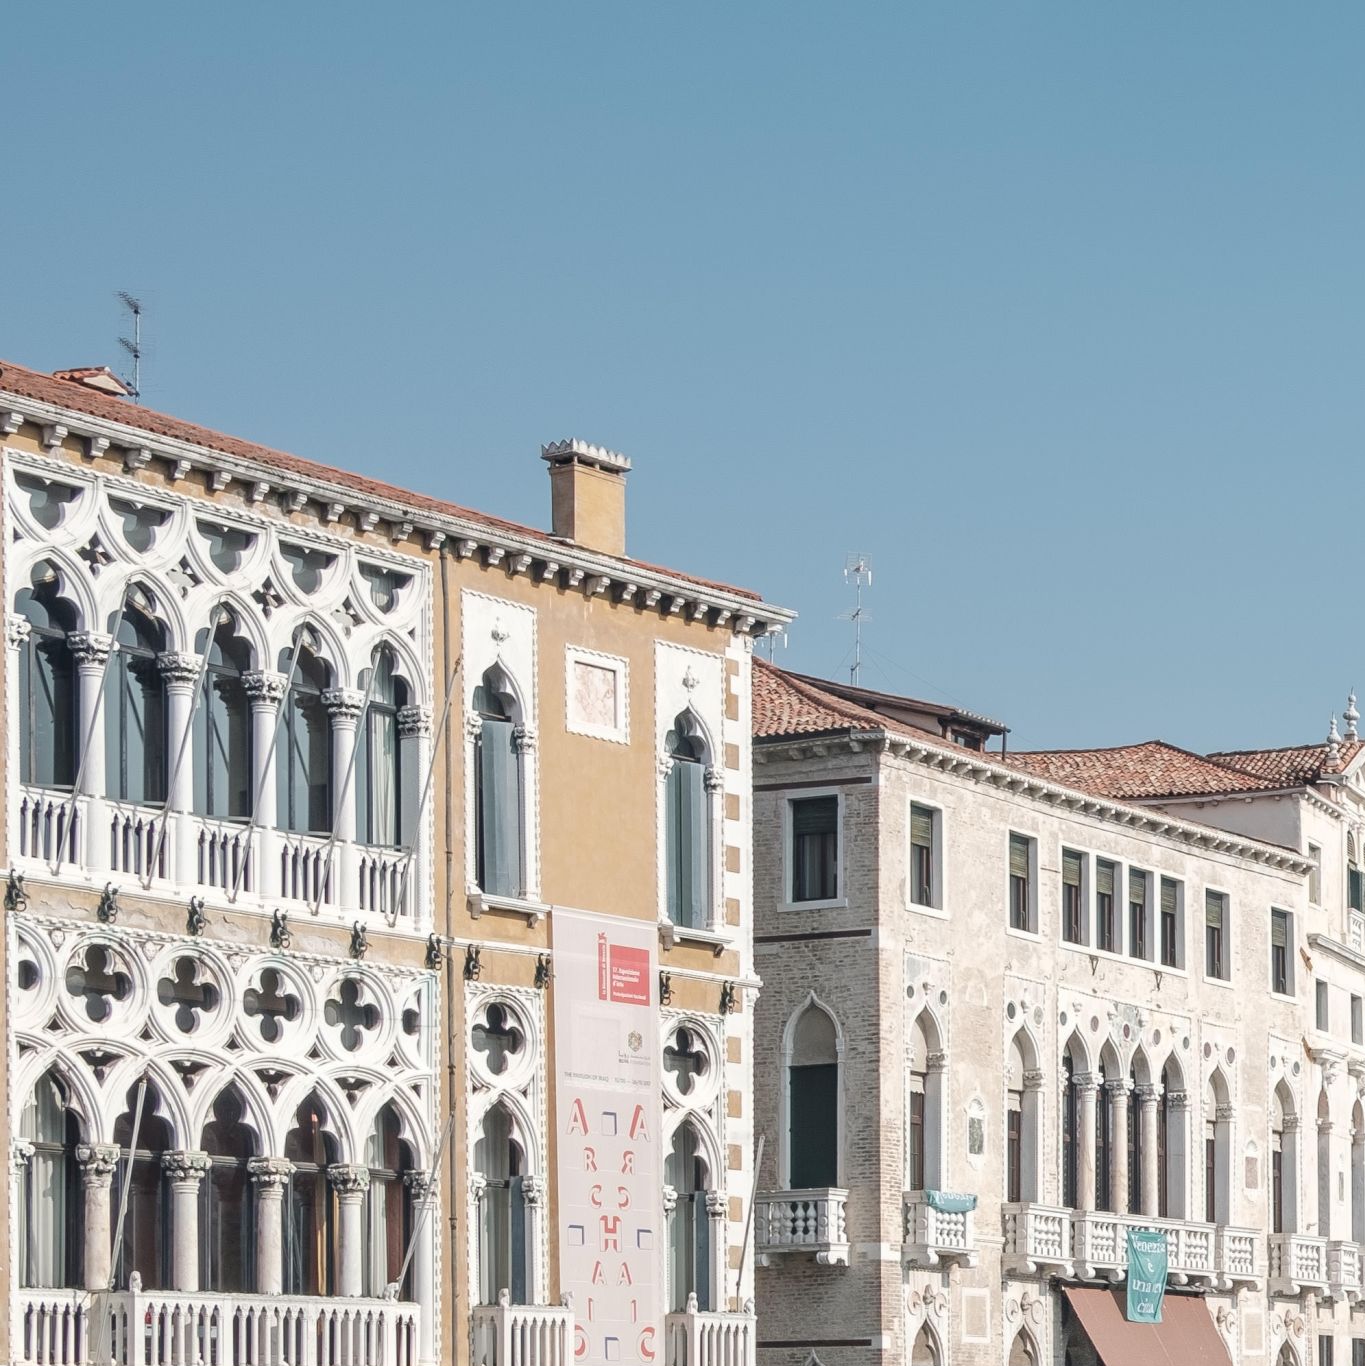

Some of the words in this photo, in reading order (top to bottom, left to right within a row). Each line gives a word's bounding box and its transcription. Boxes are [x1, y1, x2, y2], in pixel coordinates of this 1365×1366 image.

[565, 1098, 589, 1136] A
[629, 1104, 651, 1142] A
[584, 1147, 598, 1172] R
[599, 1215, 623, 1252] H
